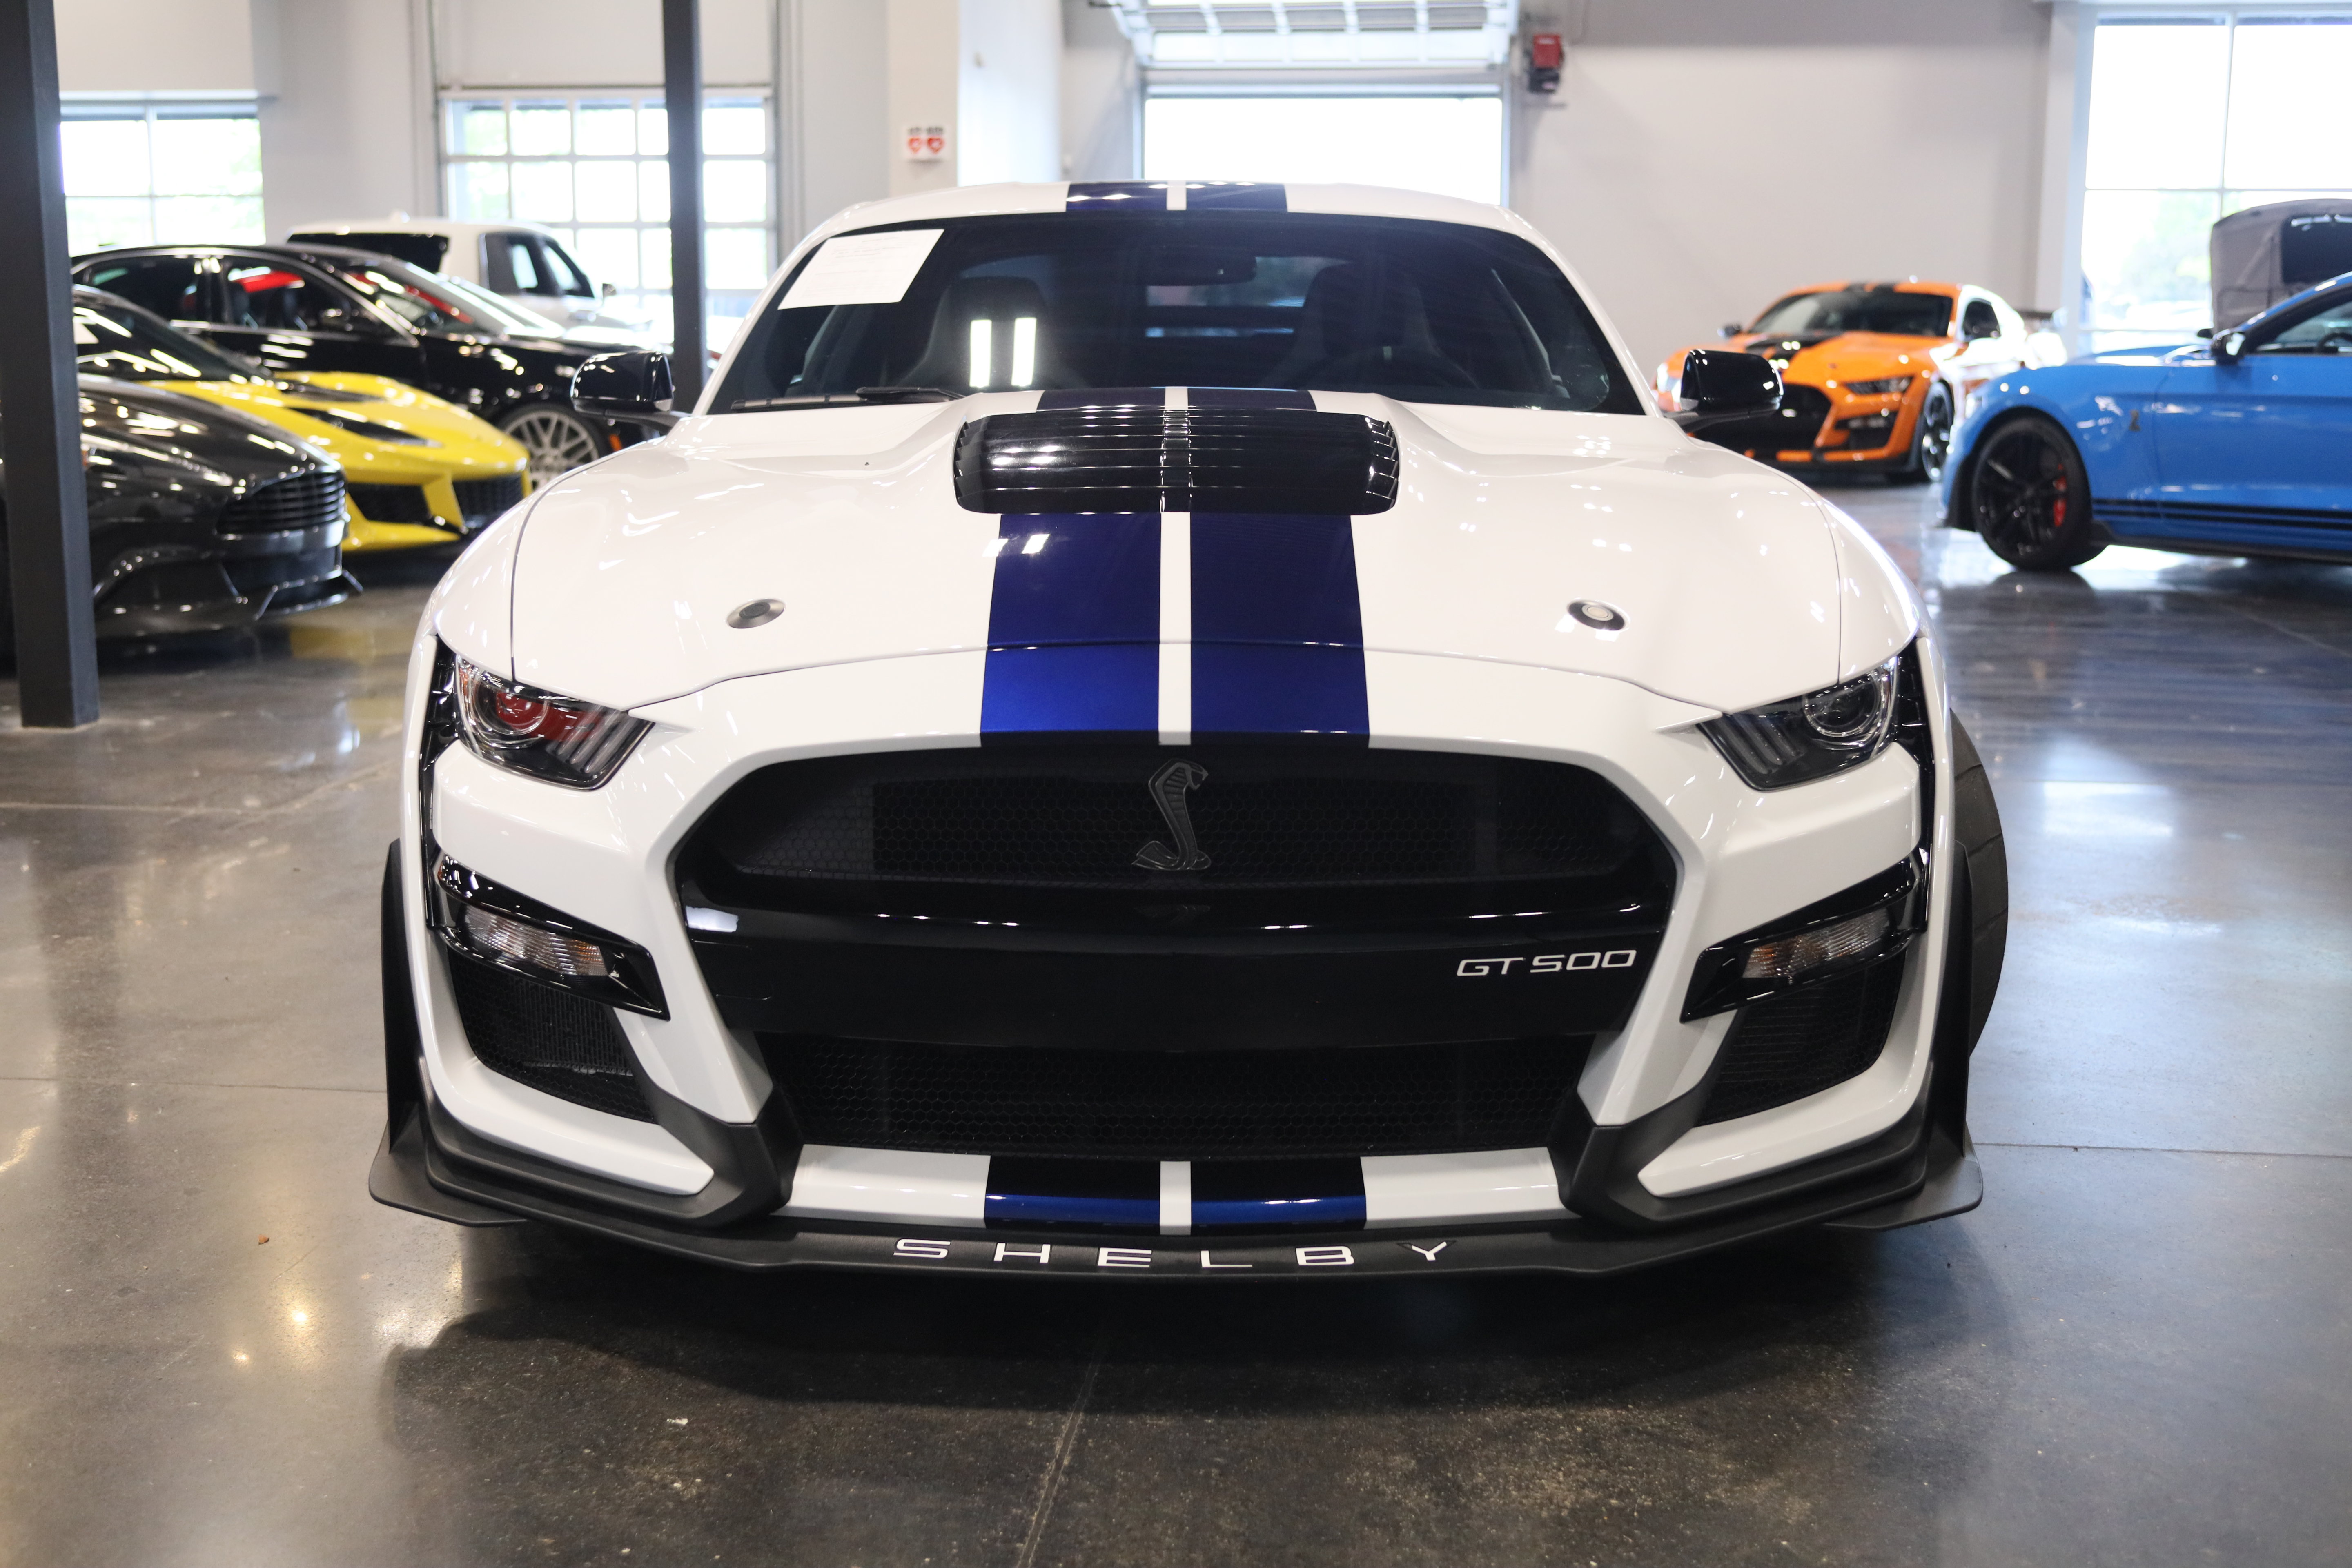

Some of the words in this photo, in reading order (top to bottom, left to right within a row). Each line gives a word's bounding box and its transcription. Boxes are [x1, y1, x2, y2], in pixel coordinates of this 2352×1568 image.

[1457, 957, 1525, 976] GT
[1530, 949, 1637, 973] 500
[893, 1238, 1457, 1268] SHELBY
